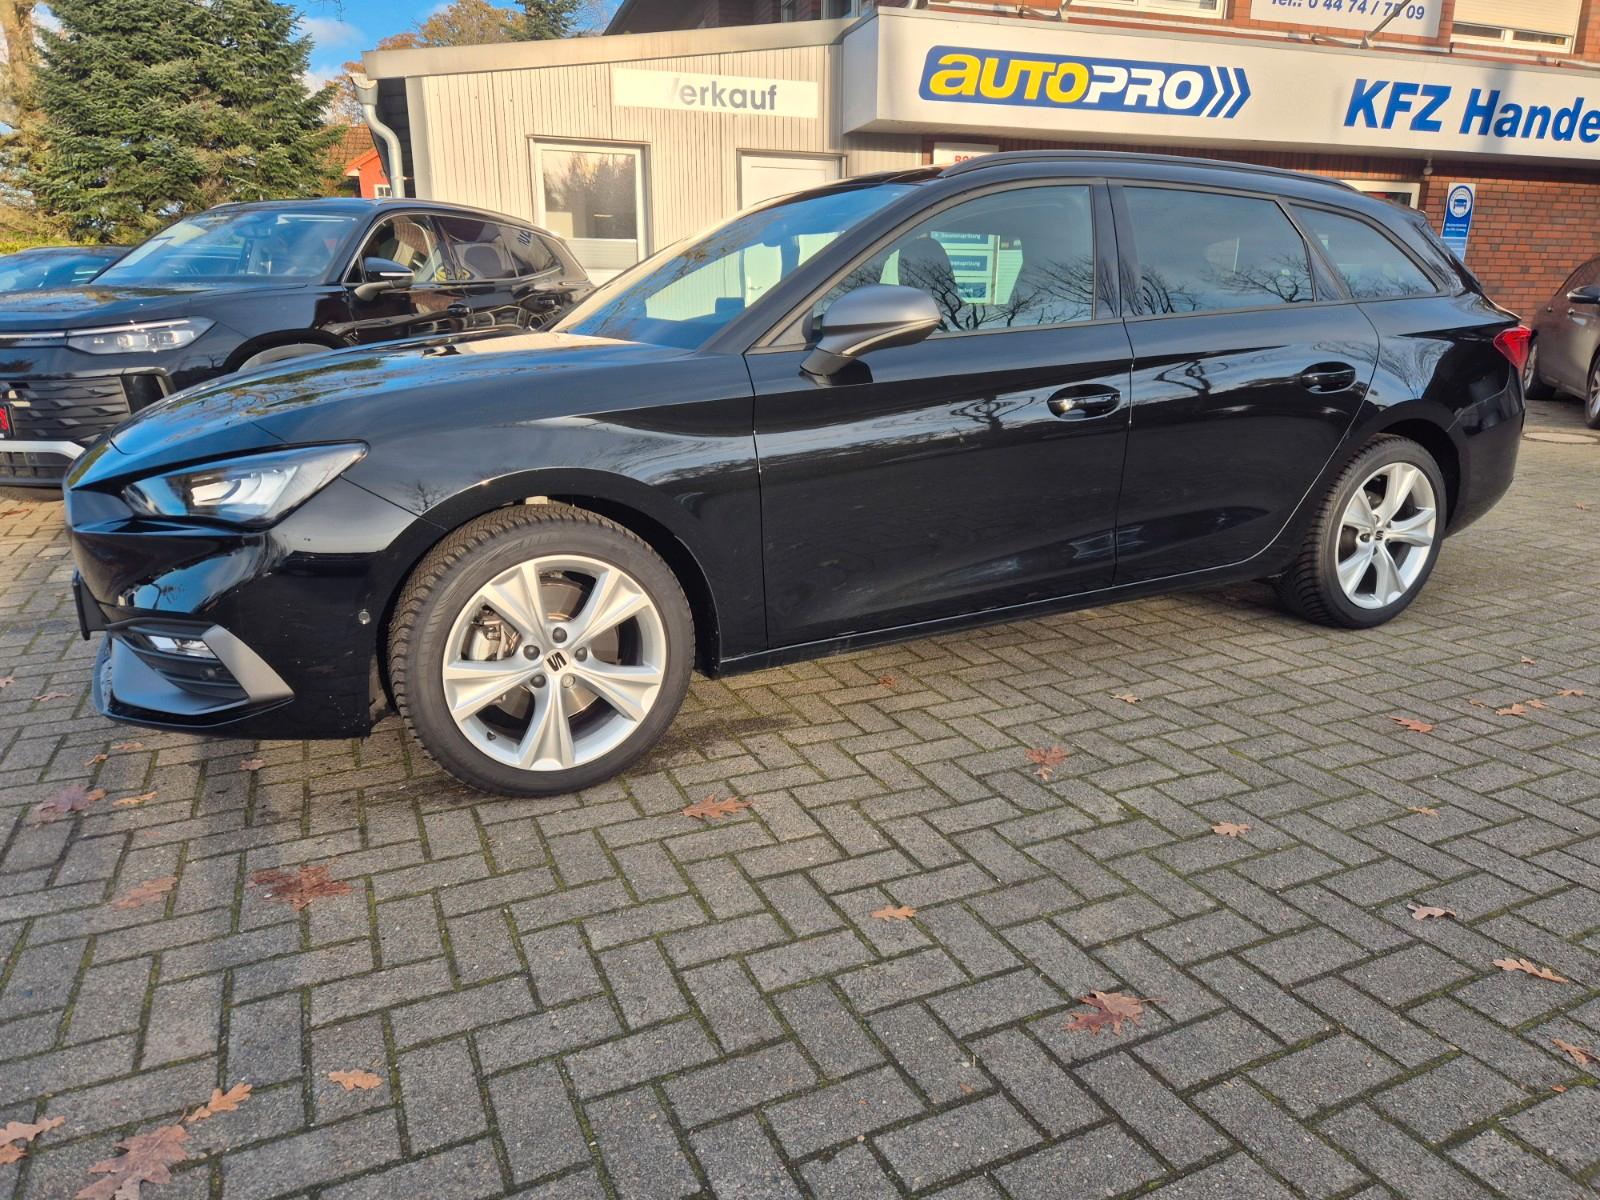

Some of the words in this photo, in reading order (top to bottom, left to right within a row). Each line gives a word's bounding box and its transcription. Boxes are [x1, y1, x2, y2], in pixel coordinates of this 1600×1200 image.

[1323, 0, 1343, 11] 44
[1348, 0, 1368, 14] 74
[1406, 5, 1425, 20] 09
[1343, 78, 1452, 133] KFZ
[1458, 88, 1600, 143] Hande
